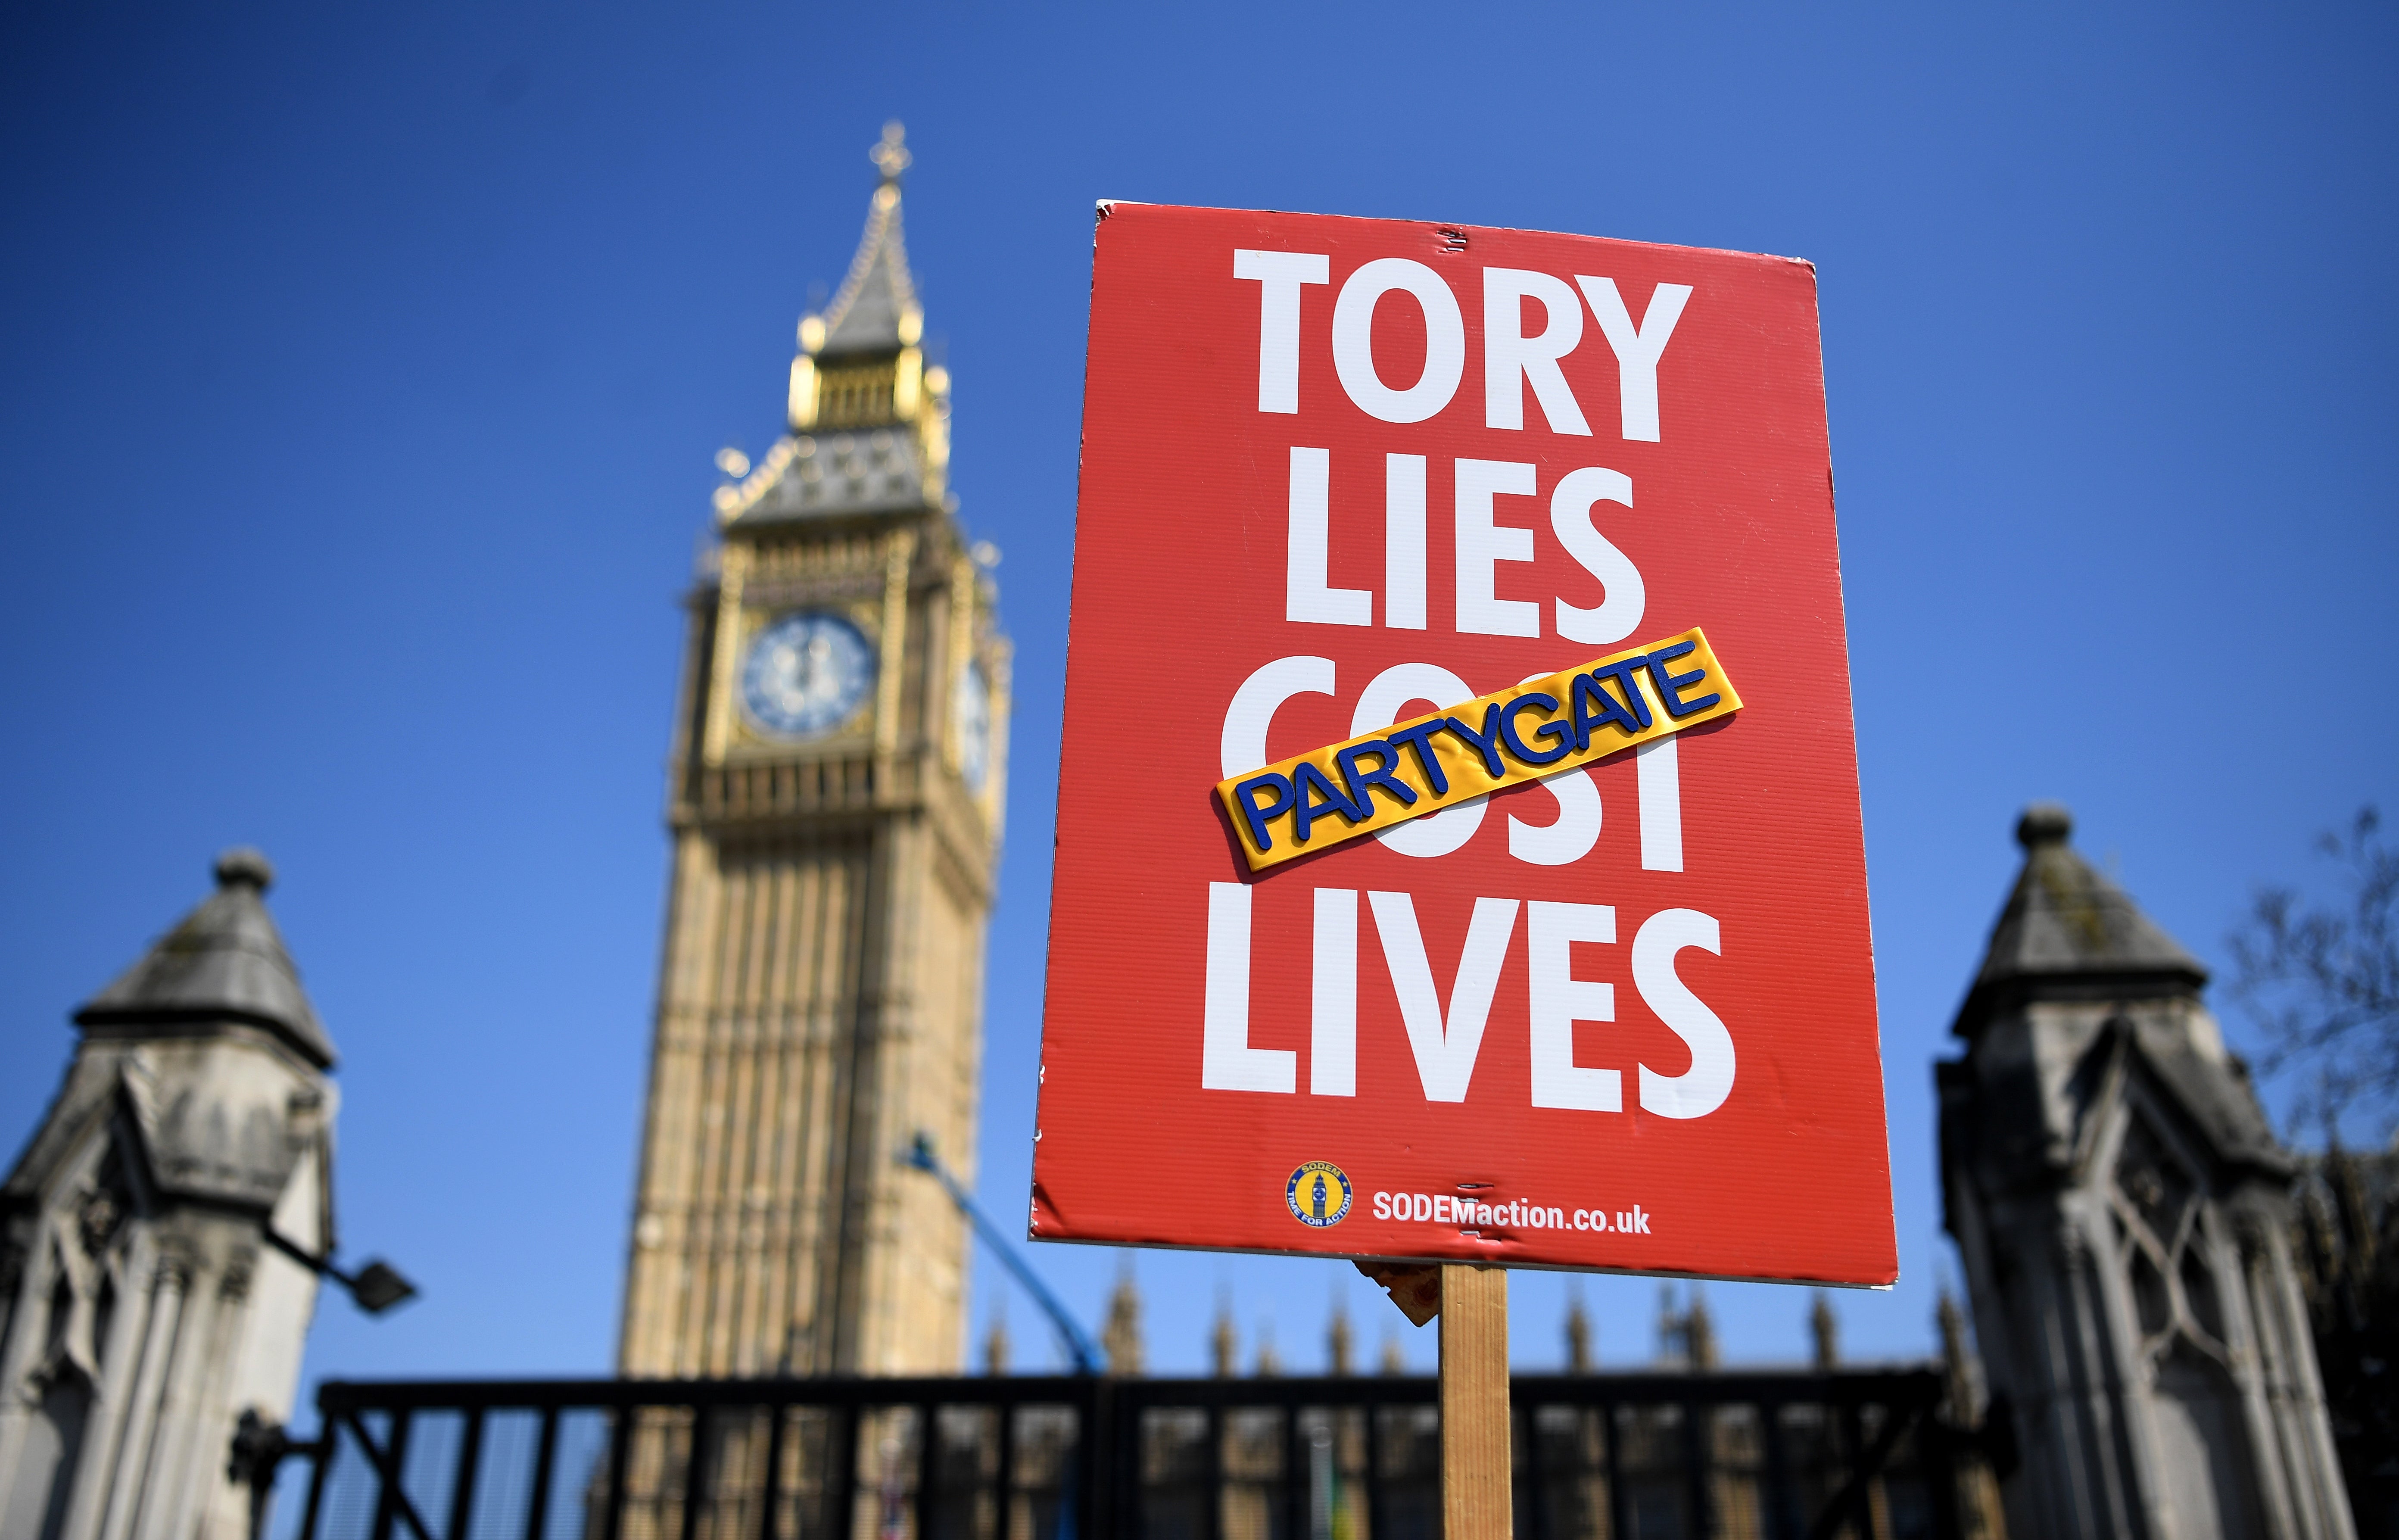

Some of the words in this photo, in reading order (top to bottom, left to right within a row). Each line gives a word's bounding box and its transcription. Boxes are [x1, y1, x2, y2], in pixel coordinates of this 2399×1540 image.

[1233, 249, 1694, 443] TORY
[1285, 446, 1645, 645] LIES
[1235, 639, 1720, 851] PARTYGATE
[1201, 881, 1736, 1120] LIVES
[1287, 1191, 1302, 1216] TIME
[1301, 1214, 1323, 1226] FOR
[1326, 1194, 1351, 1225] ACTION
[1301, 1163, 1341, 1177] SODEM
[1373, 1191, 1651, 1234] SODEMaction.co.uk
